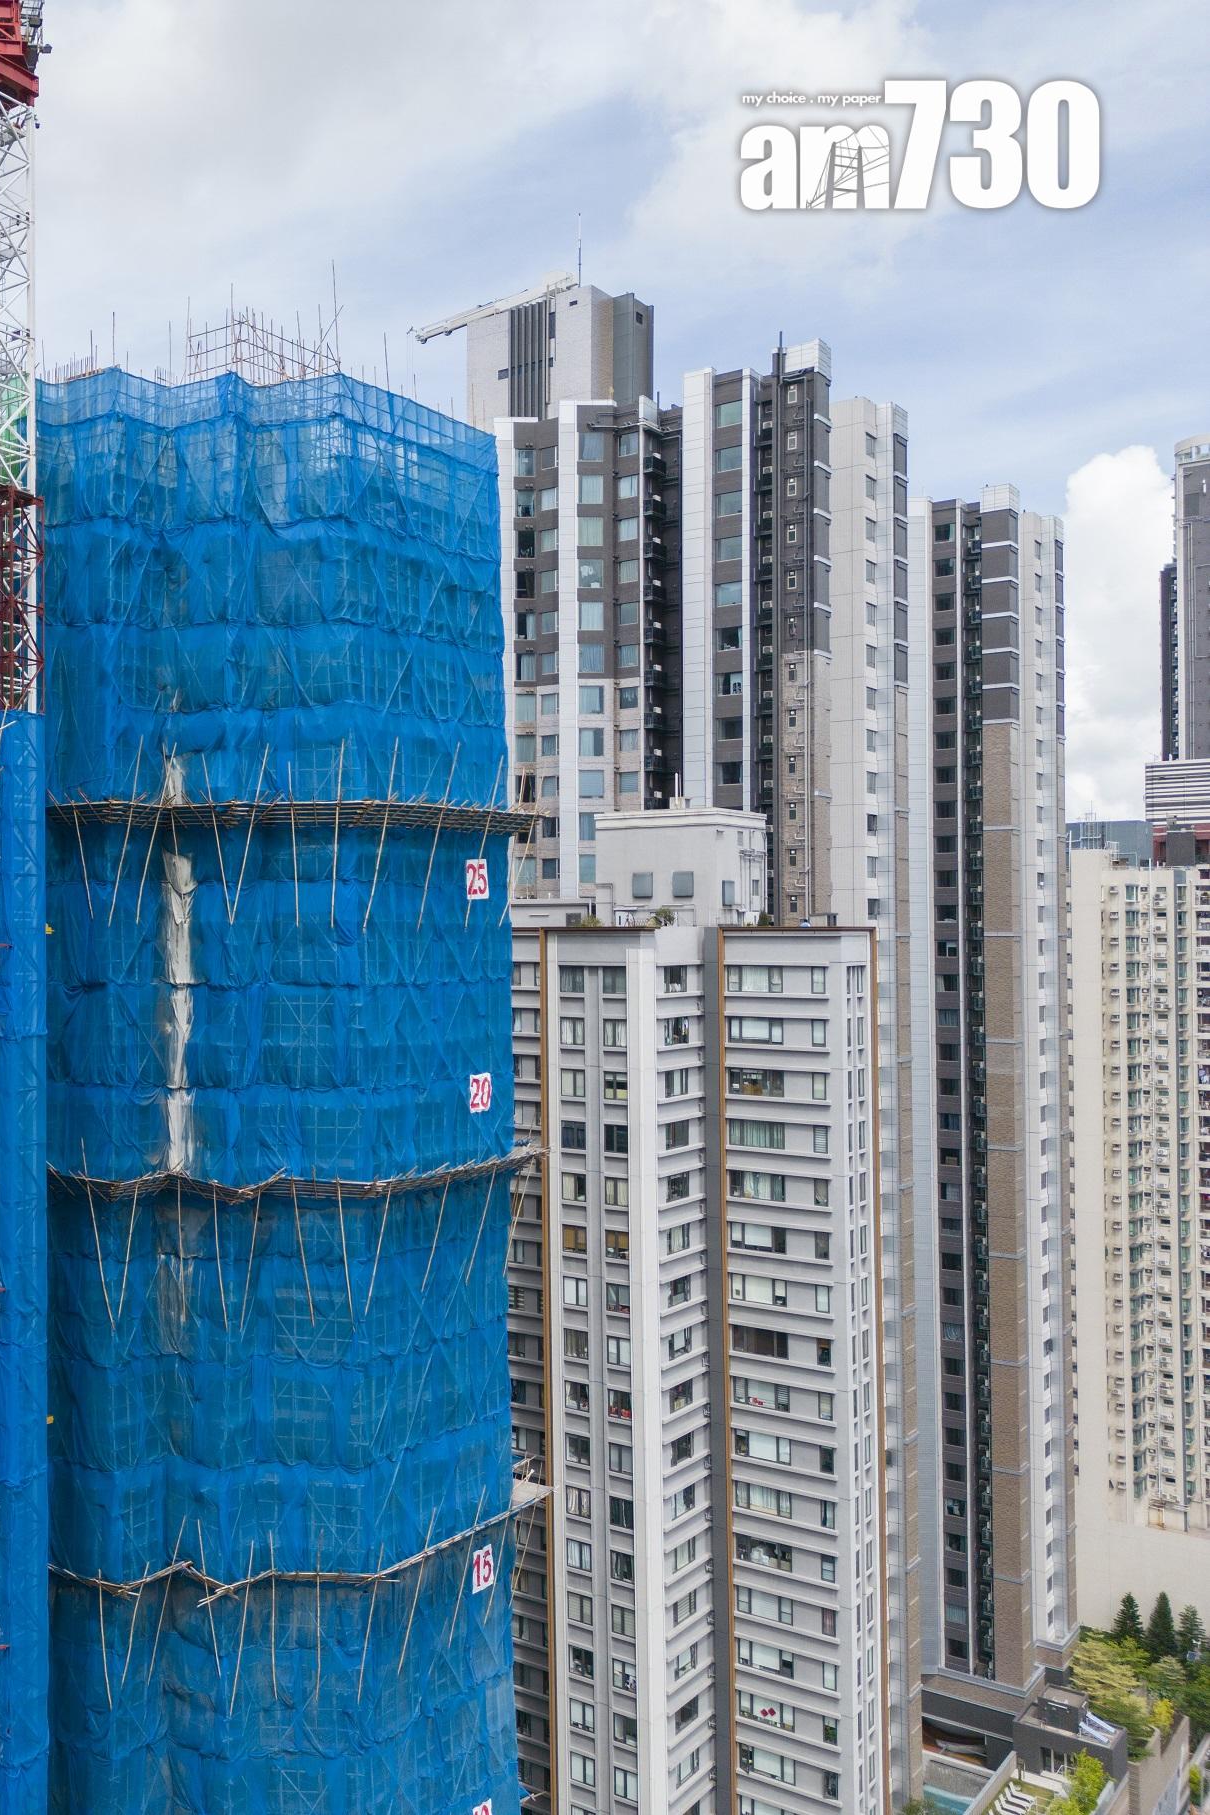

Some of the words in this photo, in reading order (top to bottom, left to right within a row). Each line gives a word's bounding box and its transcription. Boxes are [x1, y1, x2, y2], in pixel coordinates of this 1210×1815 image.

[466, 863, 487, 895] 25
[471, 1077, 490, 1109] 20
[474, 1550, 492, 1587] 15
